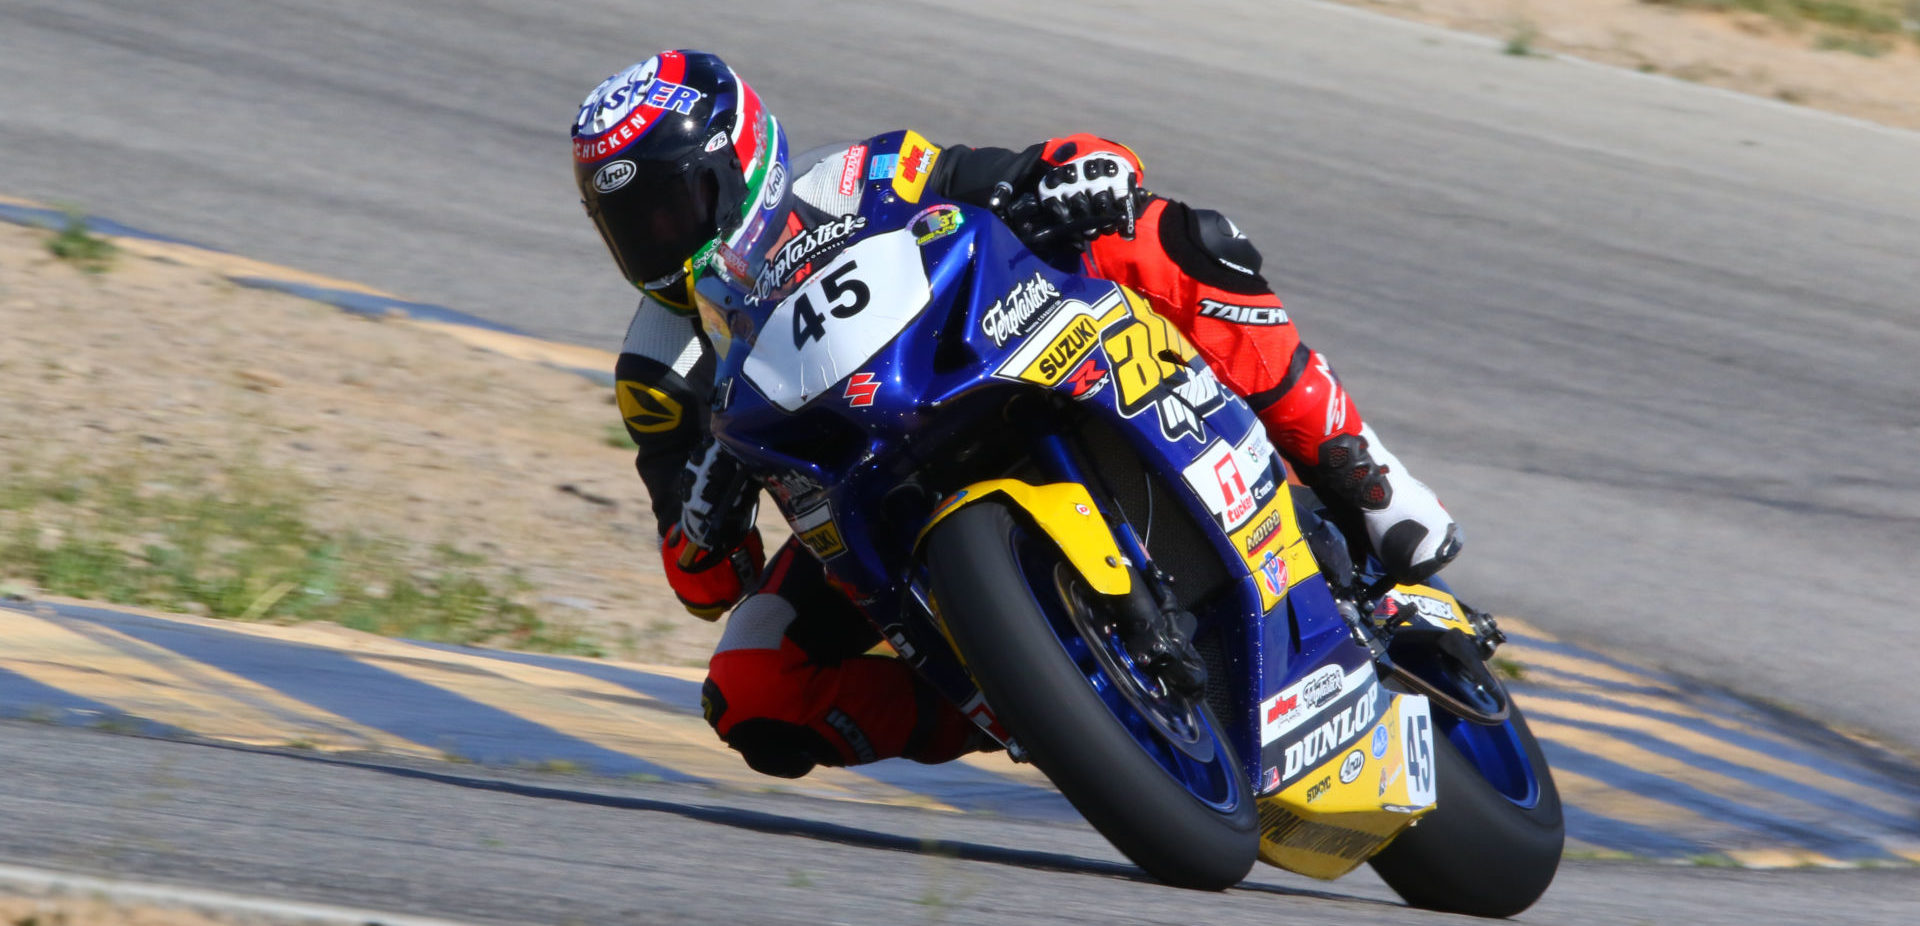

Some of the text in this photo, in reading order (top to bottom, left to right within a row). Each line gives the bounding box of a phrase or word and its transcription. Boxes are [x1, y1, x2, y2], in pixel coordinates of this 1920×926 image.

[576, 114, 646, 158] CHICKEN
[598, 165, 629, 187] Arai
[768, 171, 783, 204] Arai
[793, 261, 871, 351] 45
[1039, 320, 1097, 380] SUZUKI
[1227, 495, 1254, 523] tucker
[1282, 681, 1378, 782] DUNLOP
[1407, 715, 1431, 793] 45
